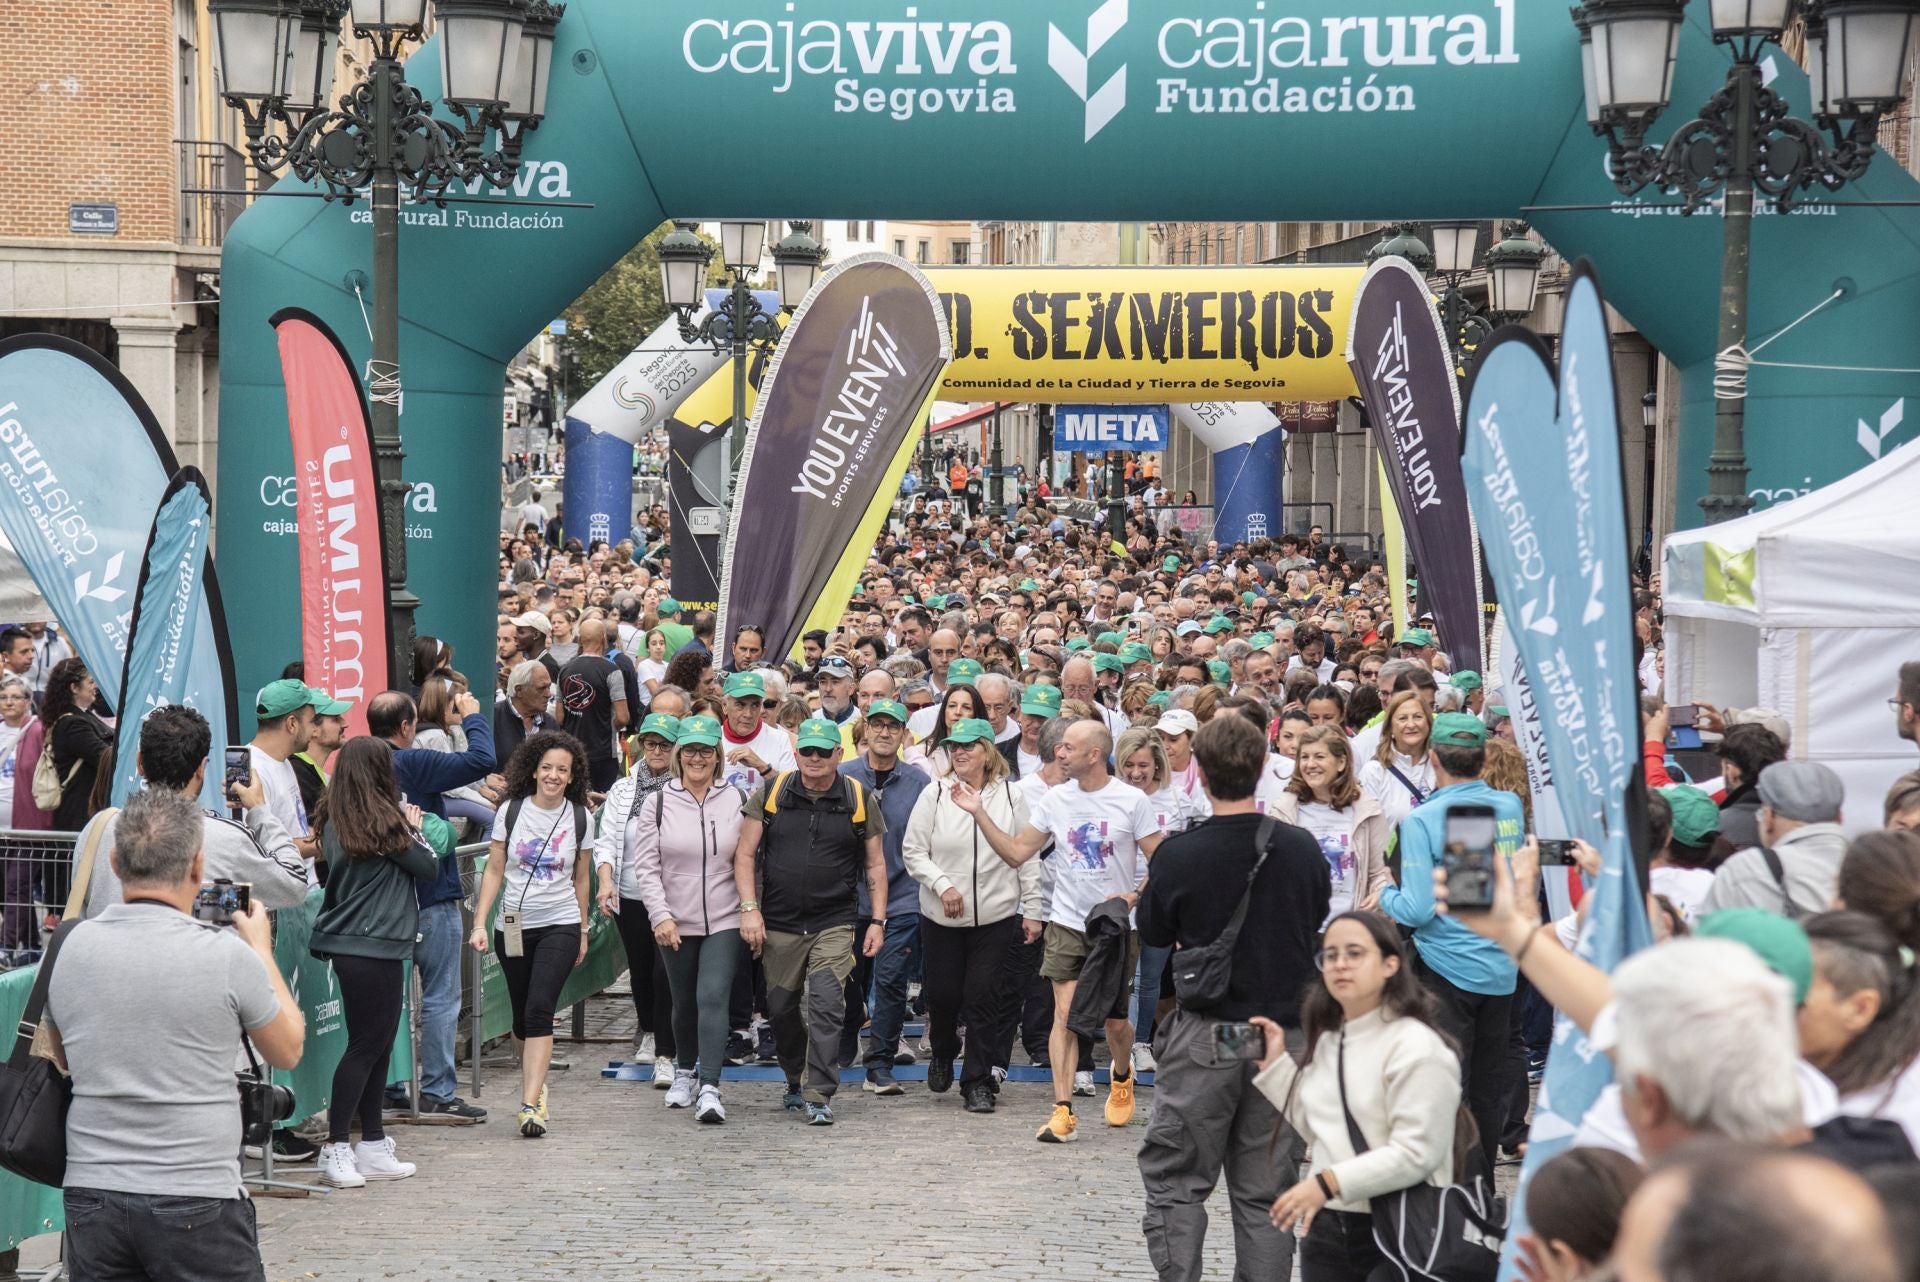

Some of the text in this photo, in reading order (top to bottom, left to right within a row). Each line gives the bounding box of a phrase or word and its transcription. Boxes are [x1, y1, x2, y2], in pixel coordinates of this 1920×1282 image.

[682, 3, 1017, 93] cajaviva
[1157, 0, 1520, 85] cajarural
[834, 79, 1017, 120] Segovia
[1155, 73, 1416, 115] Fundación
[454, 209, 565, 229] Fundación
[1008, 290, 1335, 371] SEXMEROS
[659, 363, 698, 401] 2025
[942, 378, 1286, 390] Comunidad de la Ciudad y Tierra de Segovia
[1065, 414, 1159, 442] META
[831, 405, 888, 508] SPORTS SERVICES
